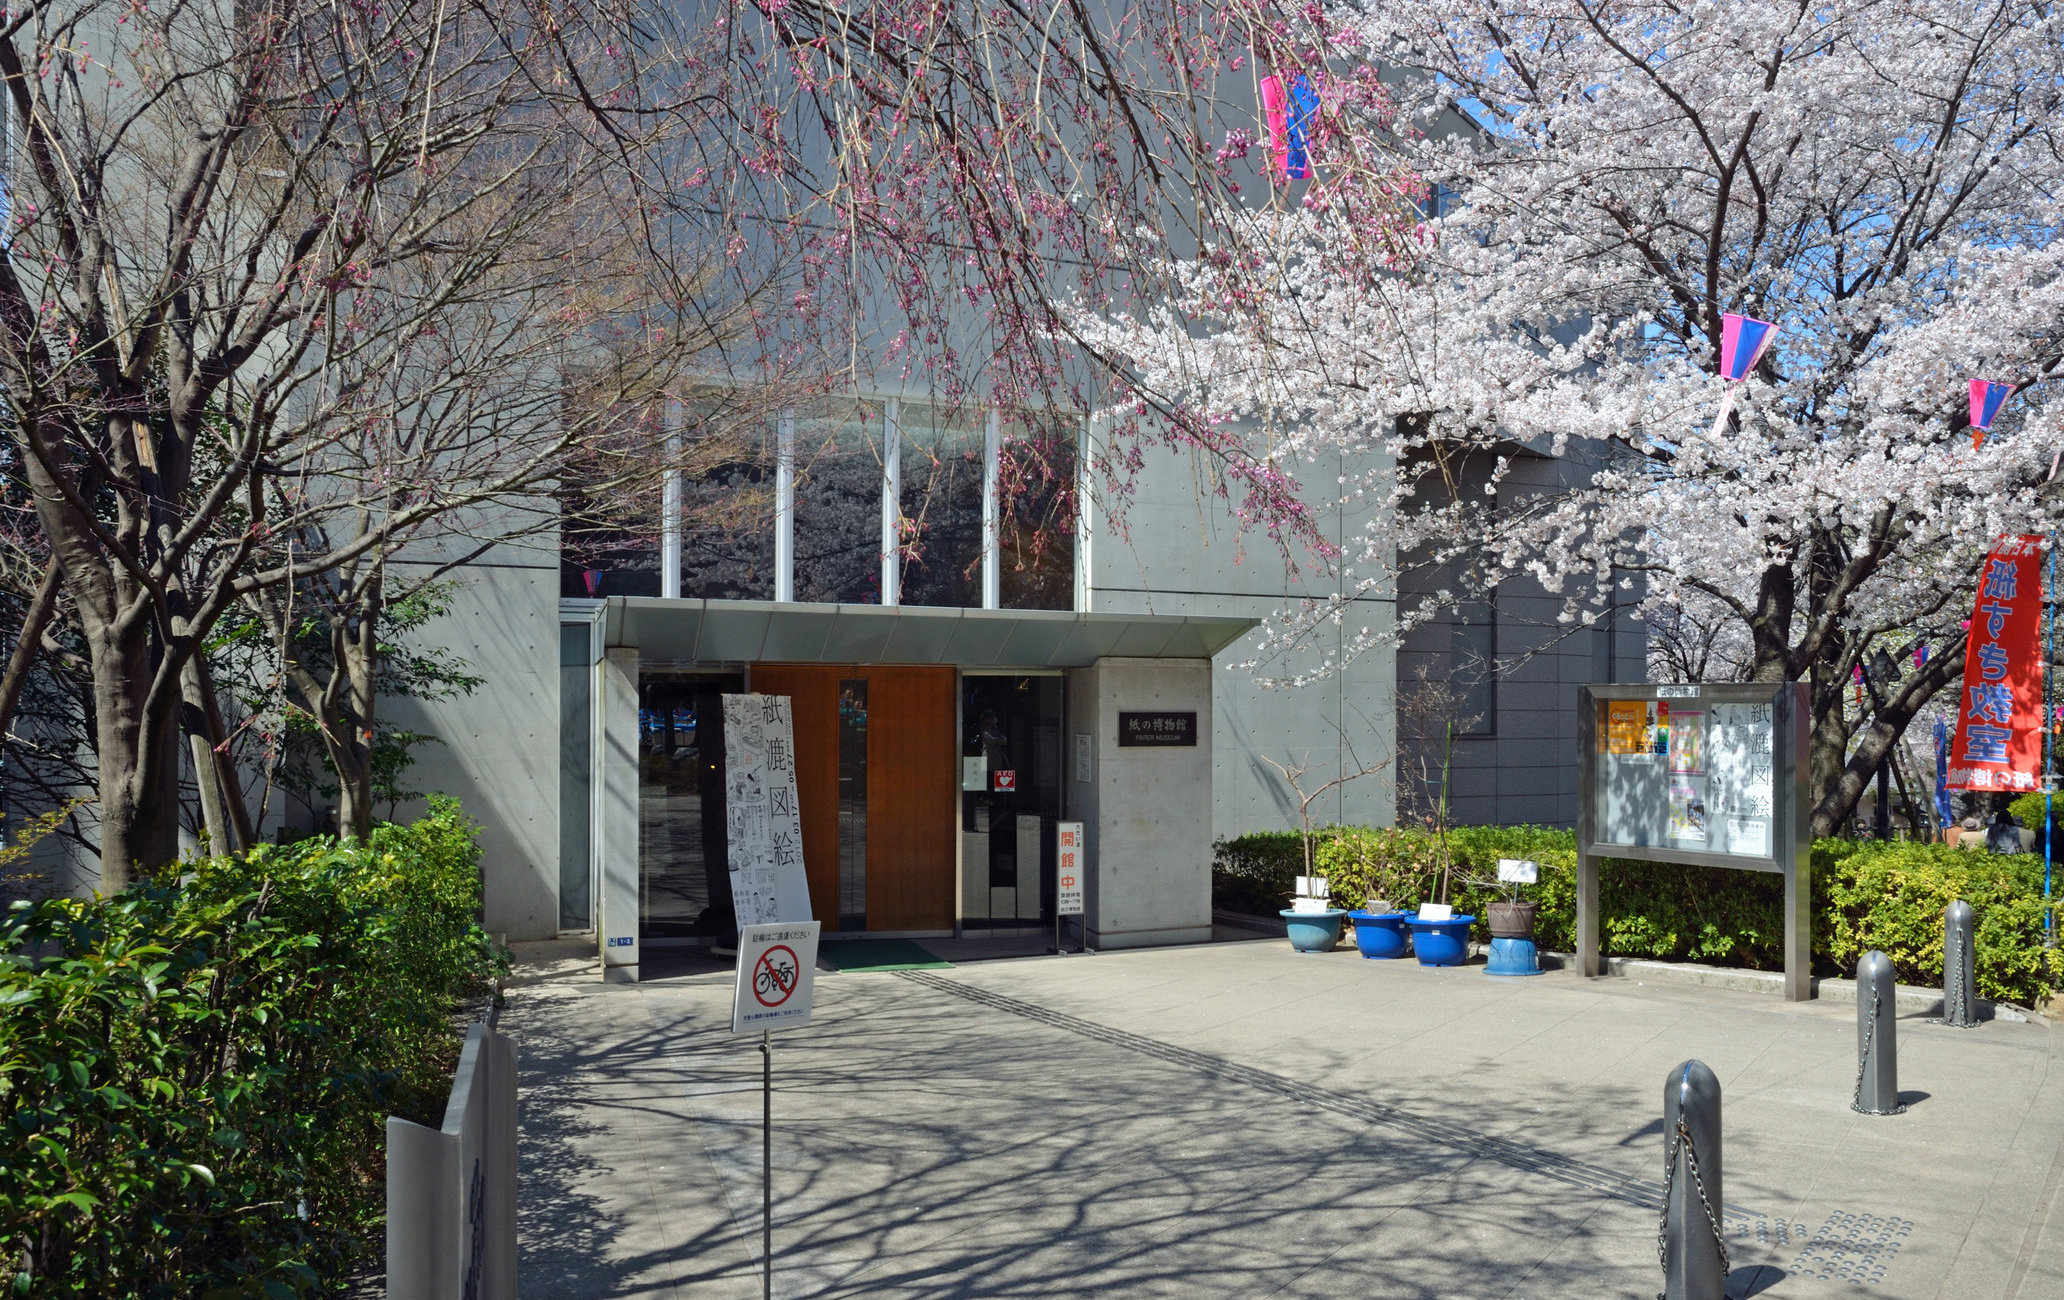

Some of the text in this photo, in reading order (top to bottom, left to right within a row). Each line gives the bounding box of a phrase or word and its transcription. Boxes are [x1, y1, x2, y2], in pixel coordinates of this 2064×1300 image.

[1128, 718, 1188, 732] 紙の博物館
[1061, 831, 1075, 890] 開館中
